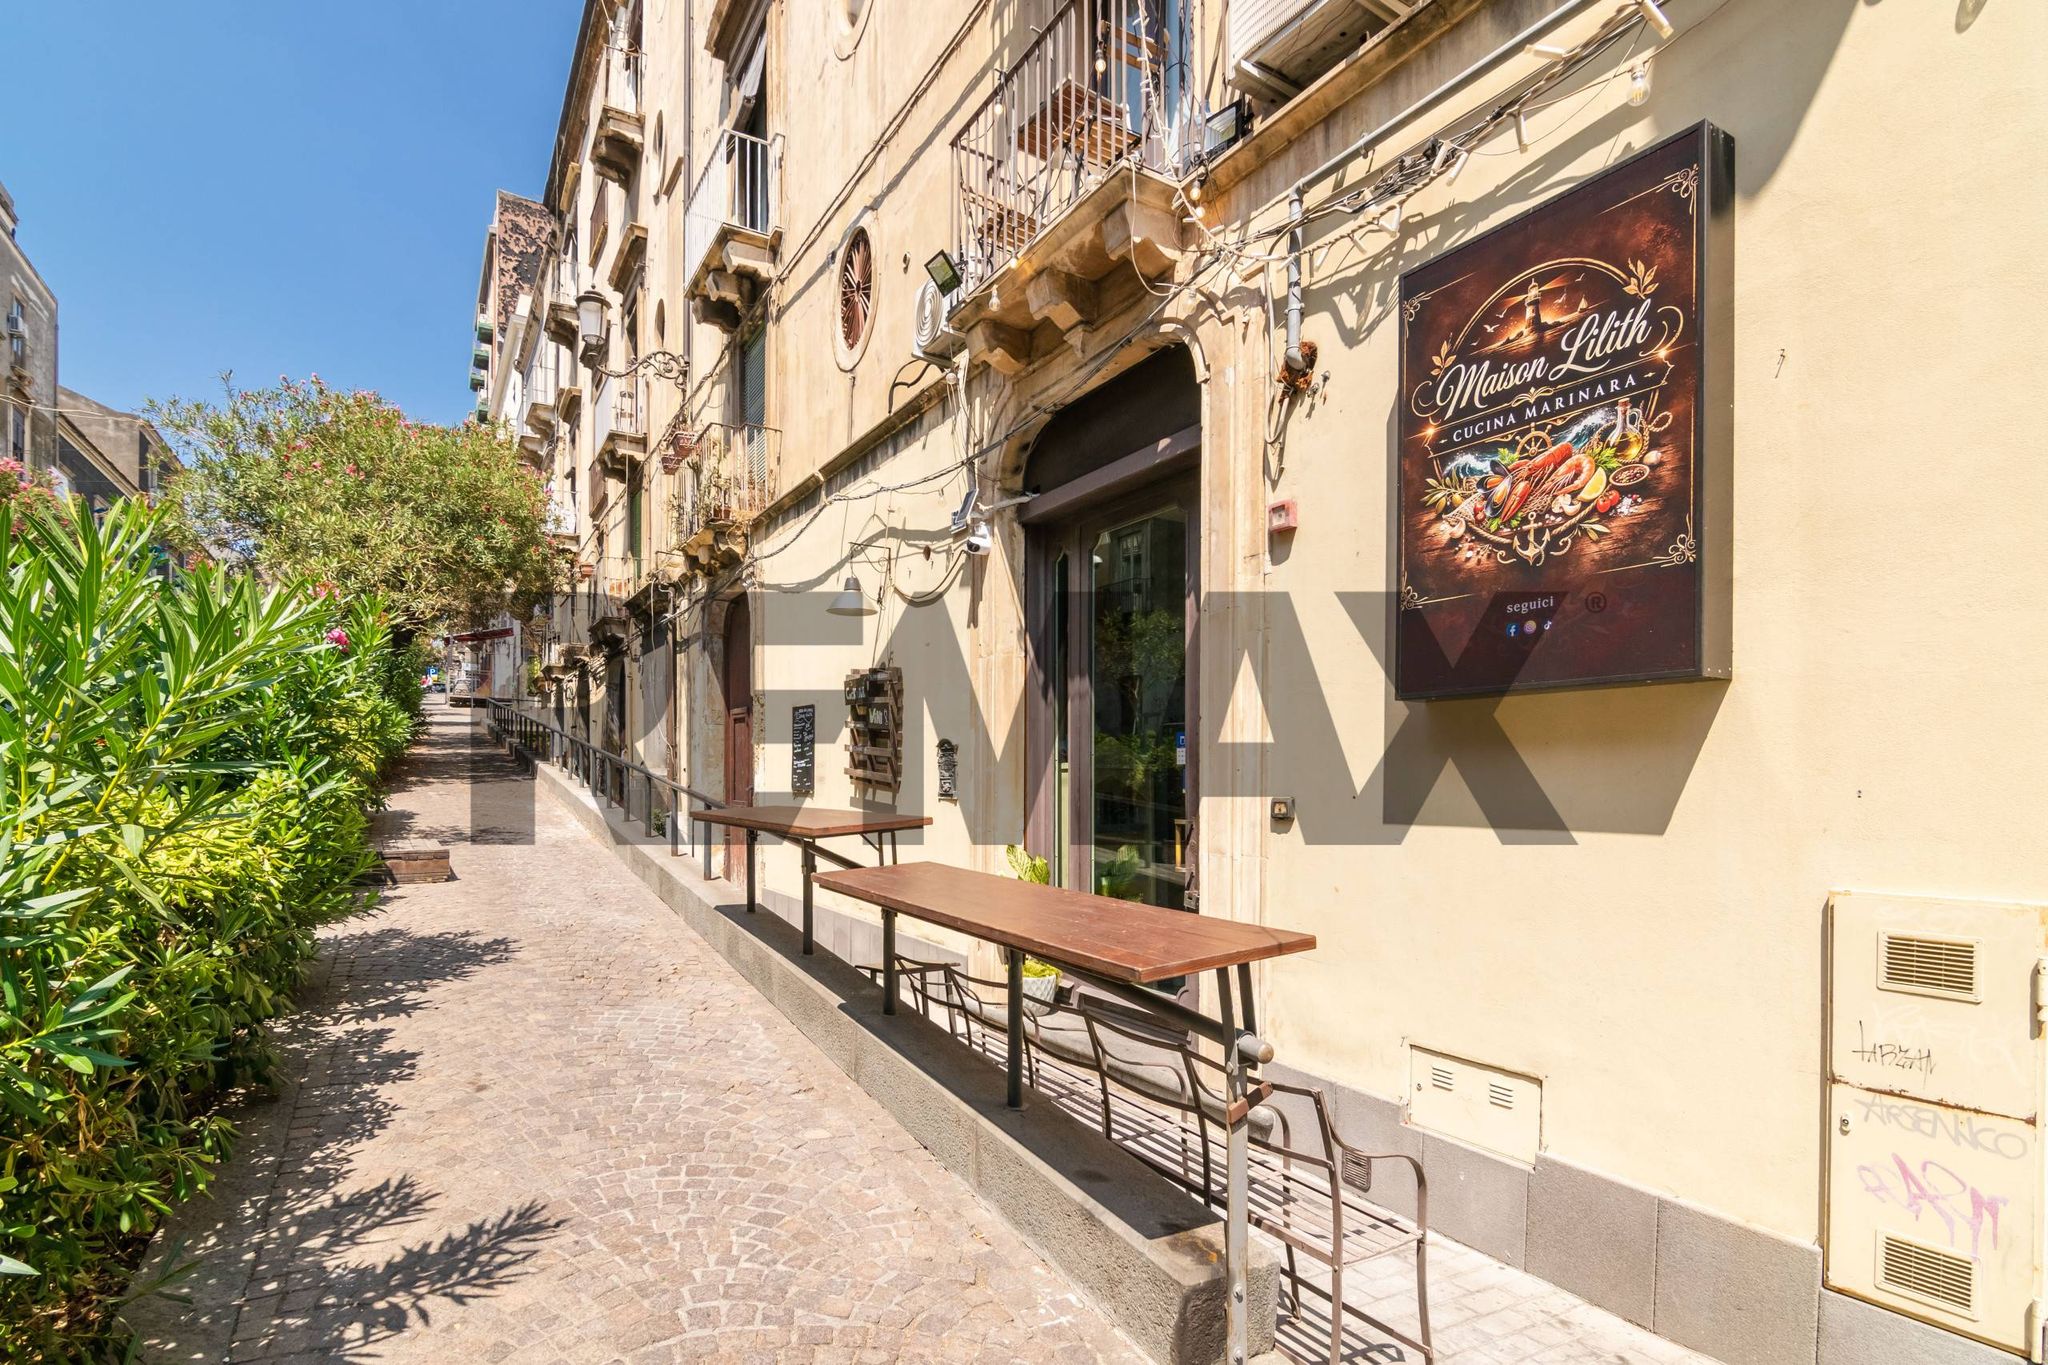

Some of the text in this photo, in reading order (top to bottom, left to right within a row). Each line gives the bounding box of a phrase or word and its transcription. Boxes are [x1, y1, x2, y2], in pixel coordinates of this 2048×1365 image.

[1436, 299, 1651, 420] Maison Lilith
[1453, 374, 1636, 443] CUCINA MARINARA
[1506, 595, 1554, 614] seguici
